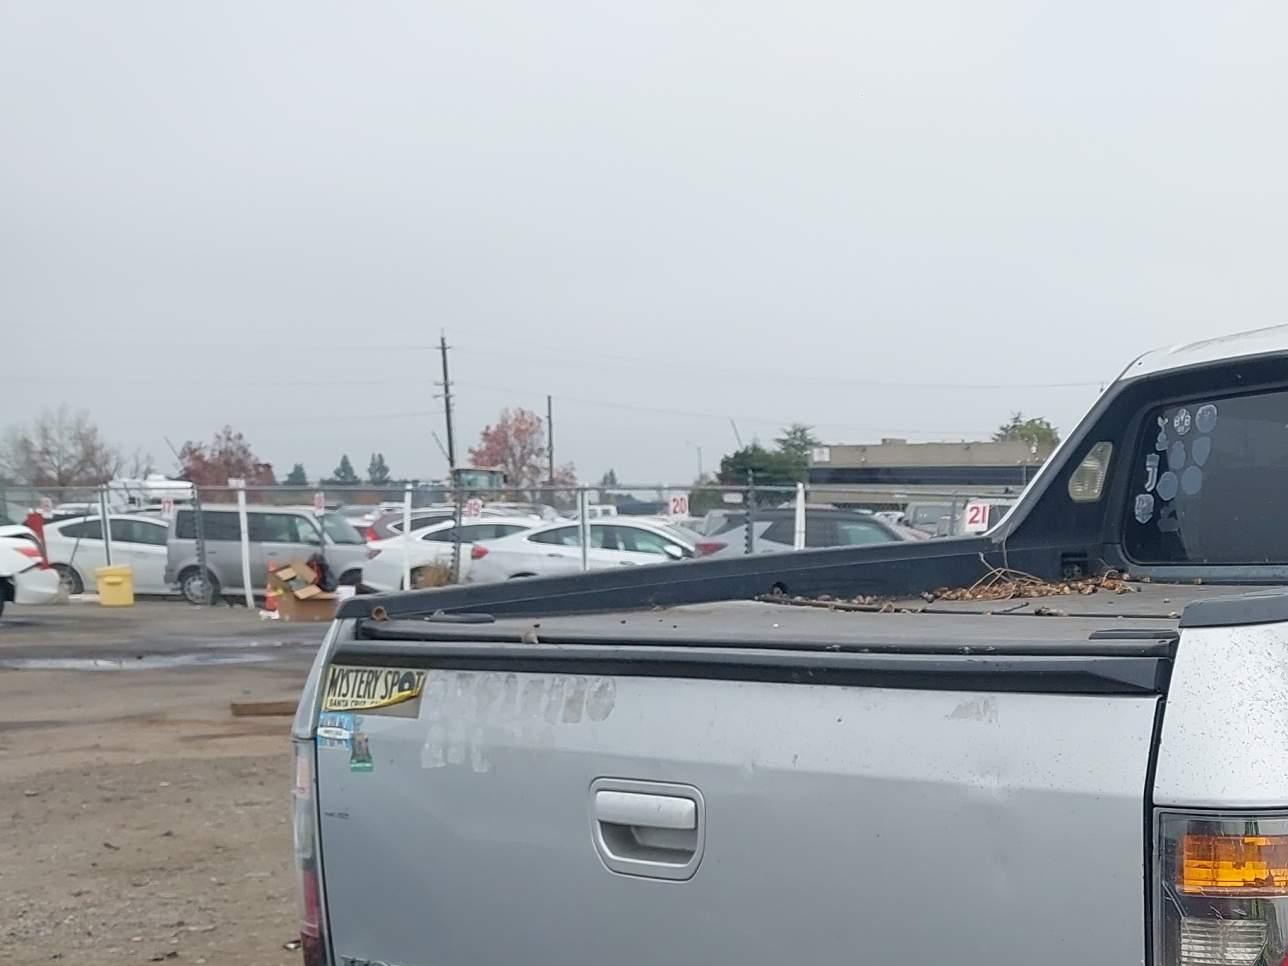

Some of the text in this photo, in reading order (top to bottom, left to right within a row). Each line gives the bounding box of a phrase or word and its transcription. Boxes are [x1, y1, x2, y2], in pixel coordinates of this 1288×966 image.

[673, 497, 689, 514] 20
[968, 505, 987, 525] 21
[327, 667, 425, 699] MYSTERY SPOT
